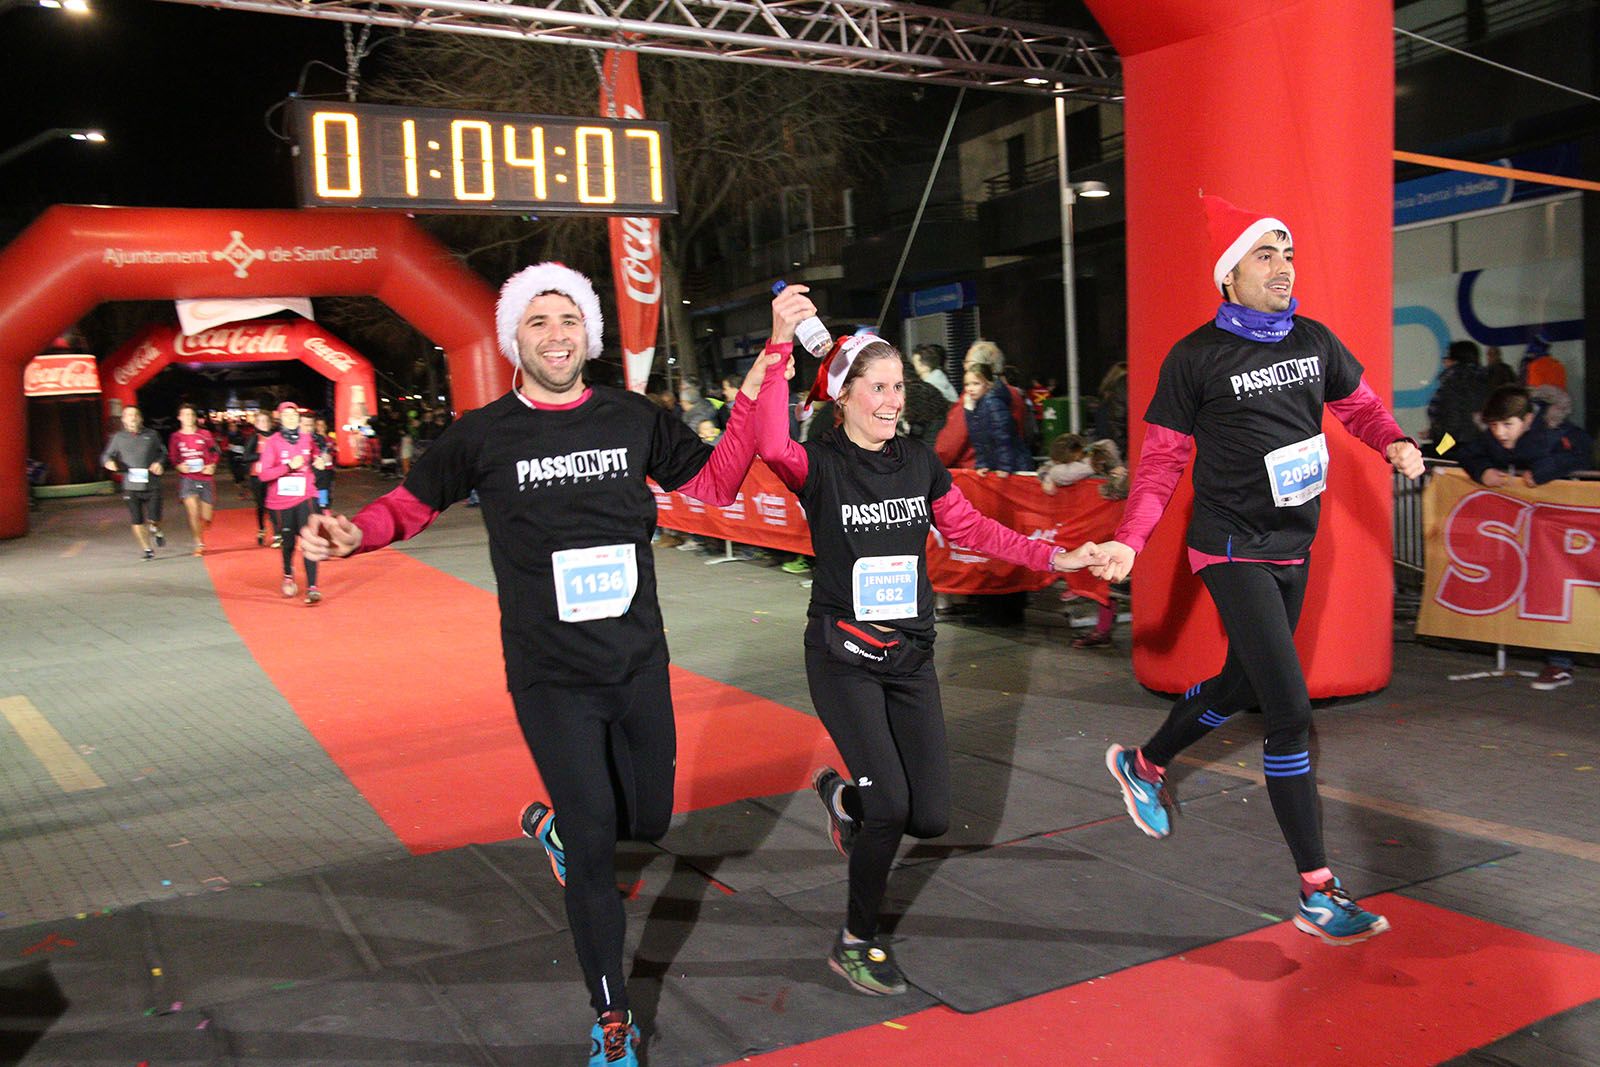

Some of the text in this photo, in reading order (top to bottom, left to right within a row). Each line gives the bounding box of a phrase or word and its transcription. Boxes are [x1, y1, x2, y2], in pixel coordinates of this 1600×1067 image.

[312, 111, 663, 204] 01:04:07
[102, 248, 210, 268] Ajuntament
[269, 248, 292, 263] de
[1230, 356, 1320, 395] PASSIONFIT
[1236, 378, 1321, 401] BARCELONA
[516, 447, 628, 484] PASSIONFIT
[1280, 460, 1319, 487] 2036
[519, 471, 629, 492] BARCELONA
[841, 496, 928, 526] PASSIONFIT
[843, 518, 929, 533] BARCELONA
[570, 570, 624, 596] 1136
[864, 574, 912, 588] JENNIFER
[876, 588, 904, 602] 682
